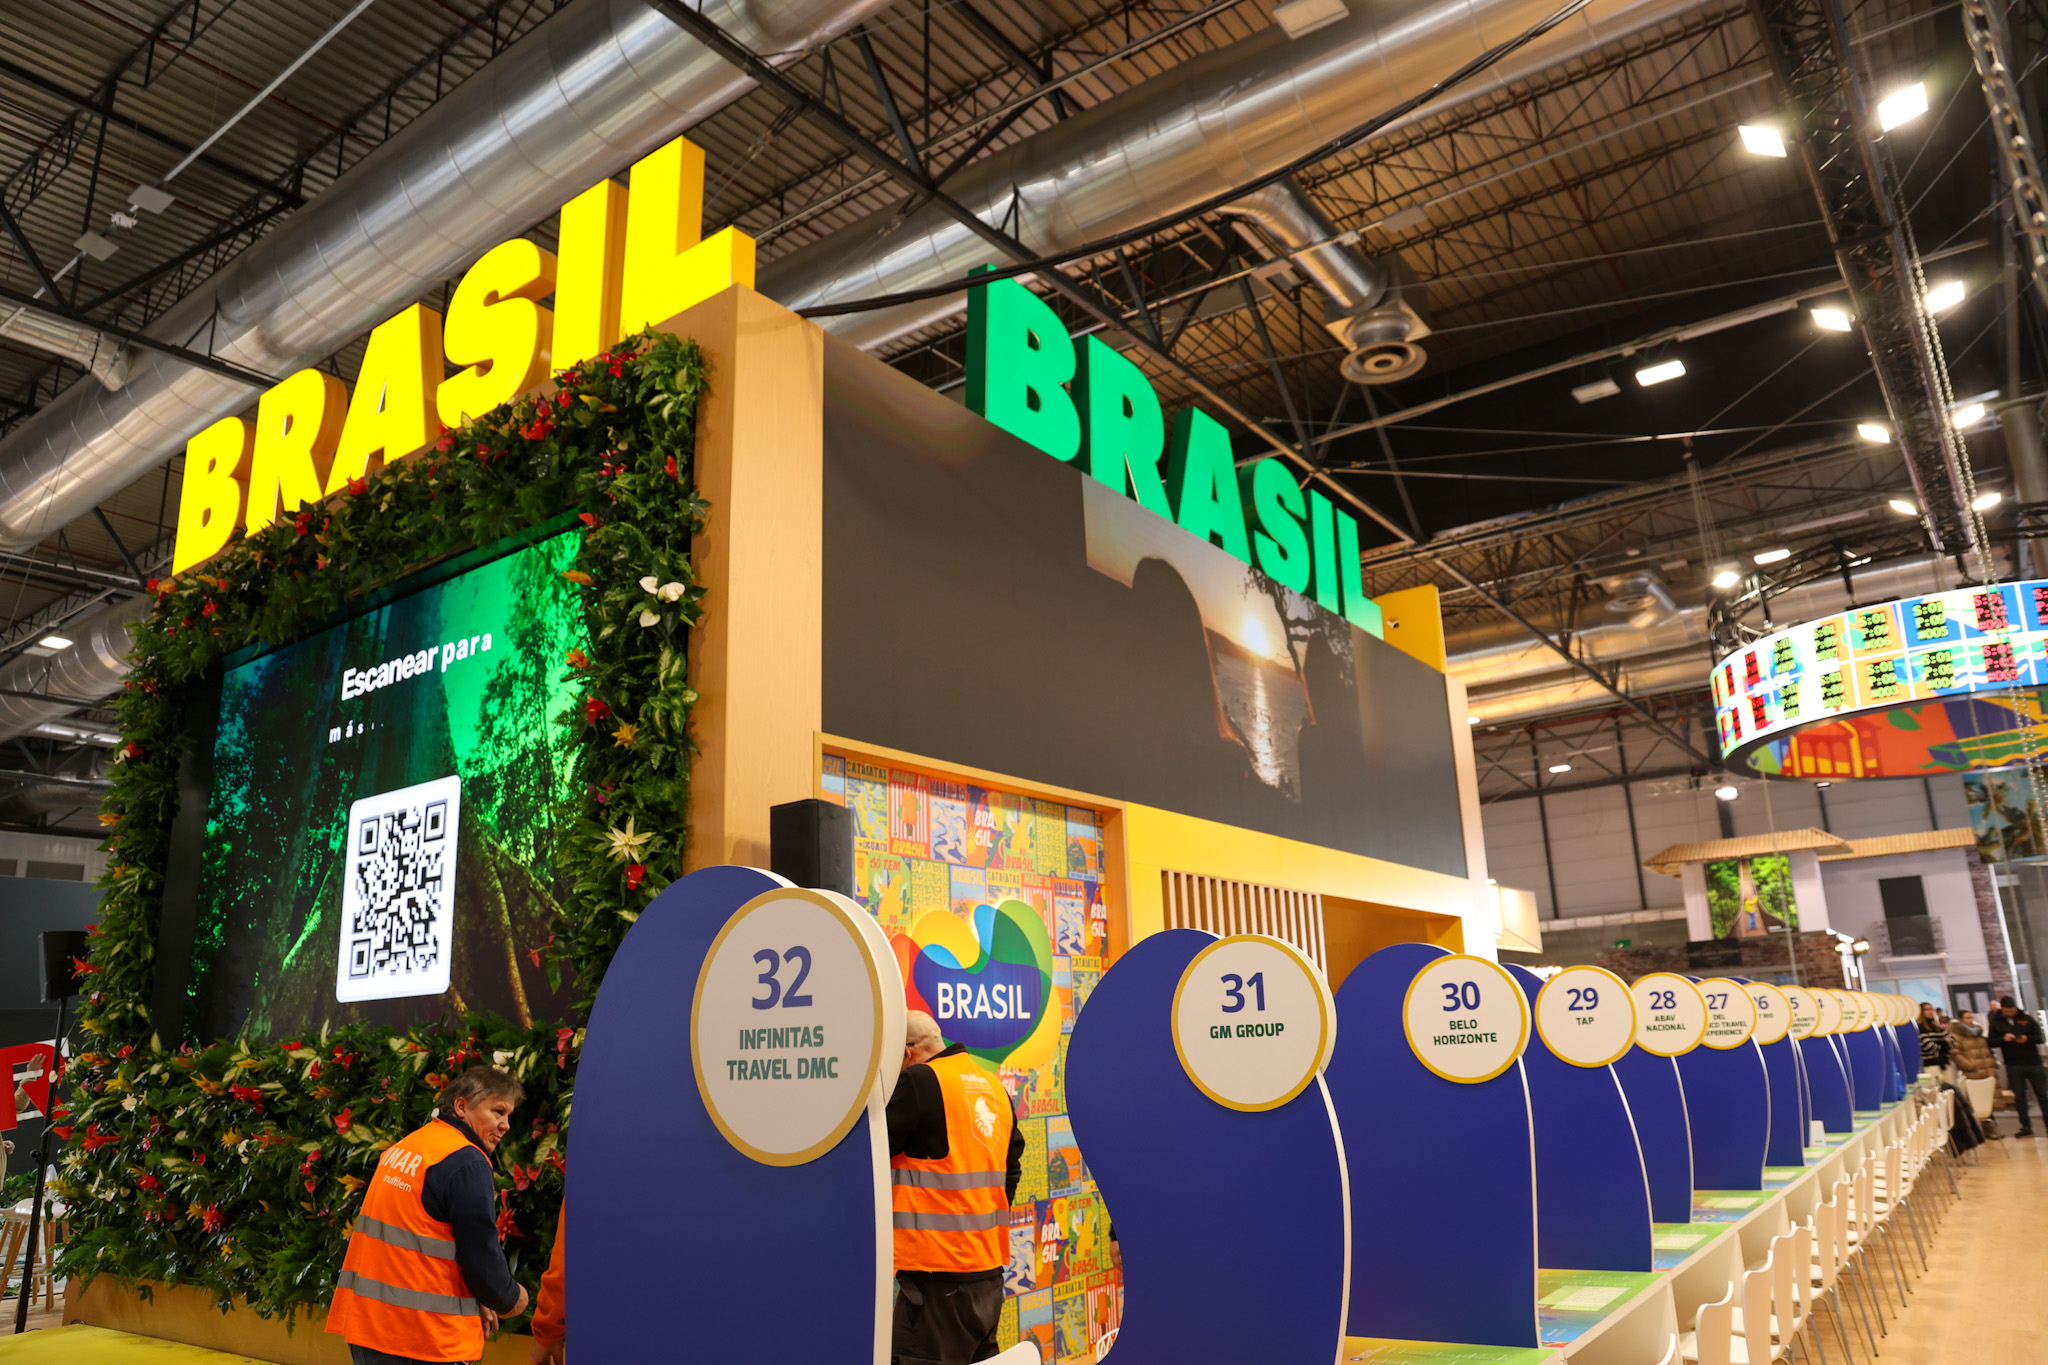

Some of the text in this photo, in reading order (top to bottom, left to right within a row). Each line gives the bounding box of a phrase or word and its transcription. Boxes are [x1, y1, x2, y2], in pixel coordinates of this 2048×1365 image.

[172, 135, 755, 577] BRASIL
[965, 262, 1384, 640] BRASIL
[341, 633, 493, 701] Escanear para
[892, 841, 928, 857] BRASIL
[752, 945, 813, 1010] 32
[937, 982, 1031, 1020] BRASIL
[1220, 972, 1265, 1013] 31
[1441, 981, 1481, 1012] 30
[1567, 987, 1599, 1011] 29
[1649, 991, 1676, 1010] 28
[1706, 993, 1728, 1009] 27
[1210, 1023, 1284, 1039] GM GROUP
[1449, 1019, 1477, 1030] BELO
[1576, 1017, 1594, 1025] TAP
[1646, 1023, 1687, 1032] NACIONAL
[740, 1025, 824, 1050] INFINITAS
[1433, 1032, 1497, 1046] HORIZONTE
[726, 1057, 838, 1081] TRAVEL DMC
[1041, 1222, 1060, 1243] BRA
[1042, 1243, 1059, 1263] SIL
[1072, 1257, 1100, 1277] BRASIL
